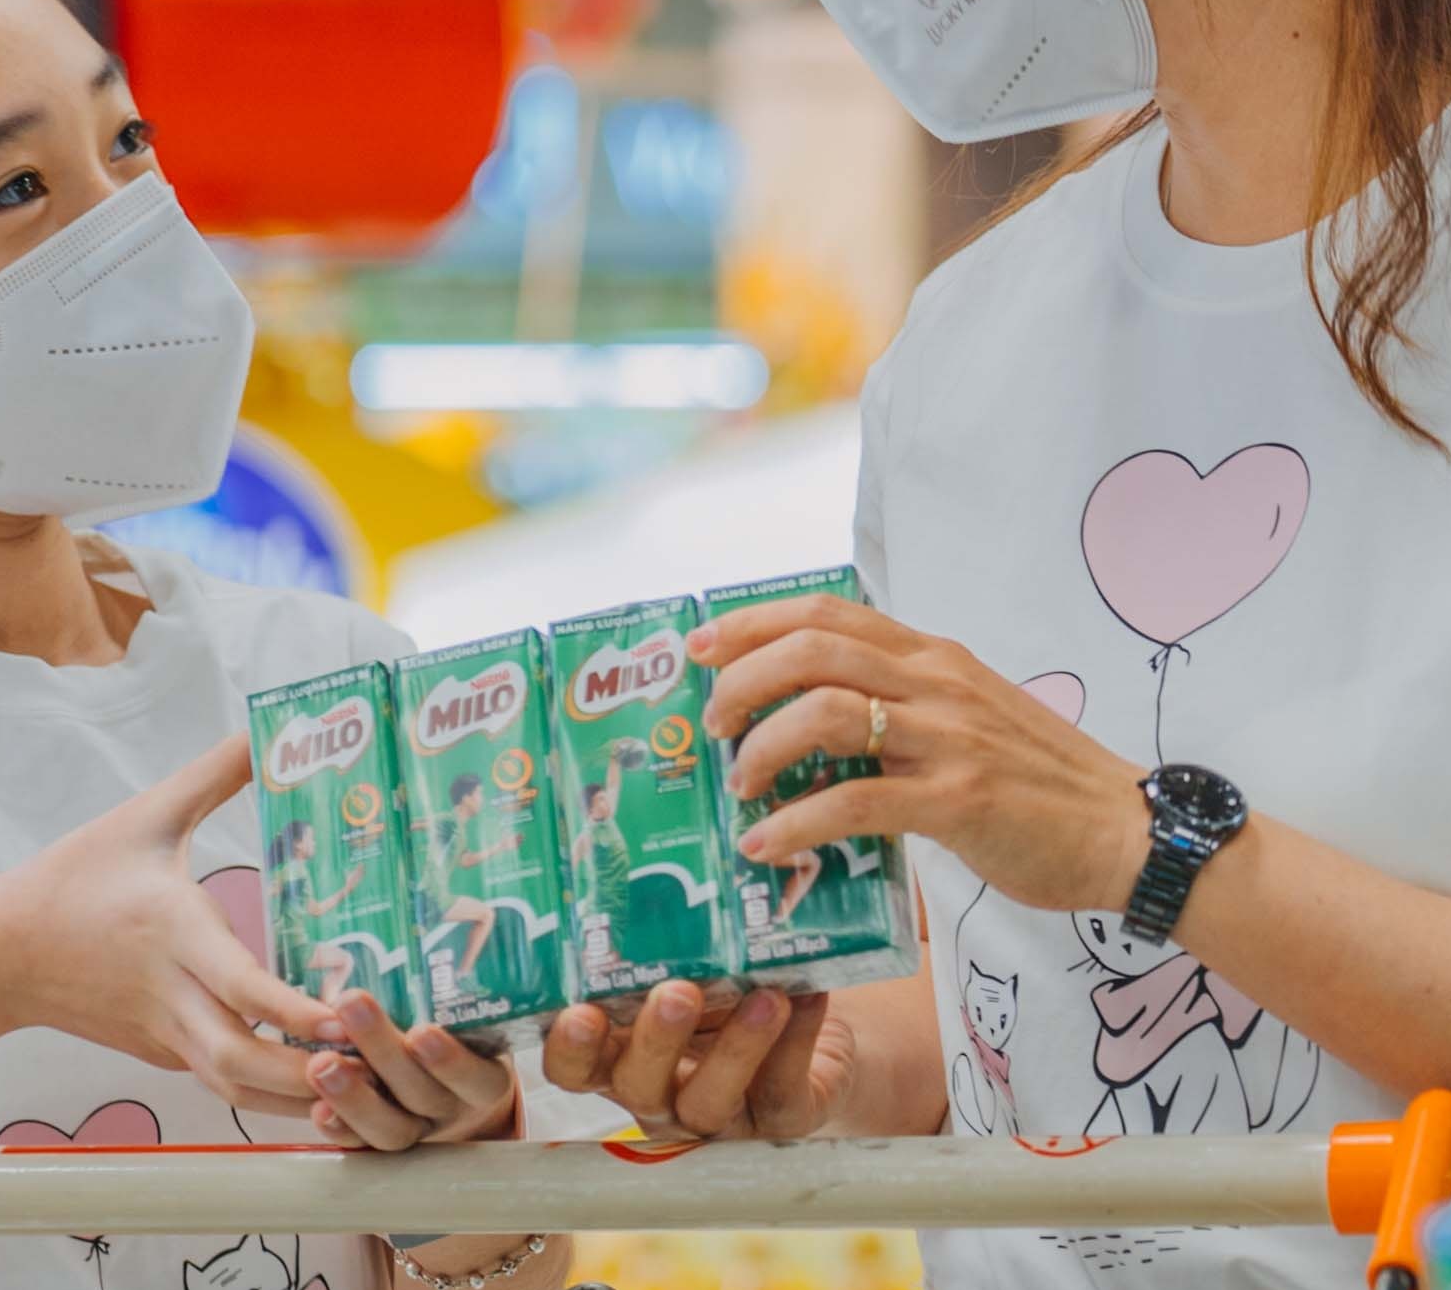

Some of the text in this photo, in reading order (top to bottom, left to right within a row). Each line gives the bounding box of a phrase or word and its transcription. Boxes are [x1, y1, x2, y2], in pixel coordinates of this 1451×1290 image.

[584, 650, 676, 704] MILO
[426, 683, 516, 739] MILO
[279, 717, 364, 775] MILO
